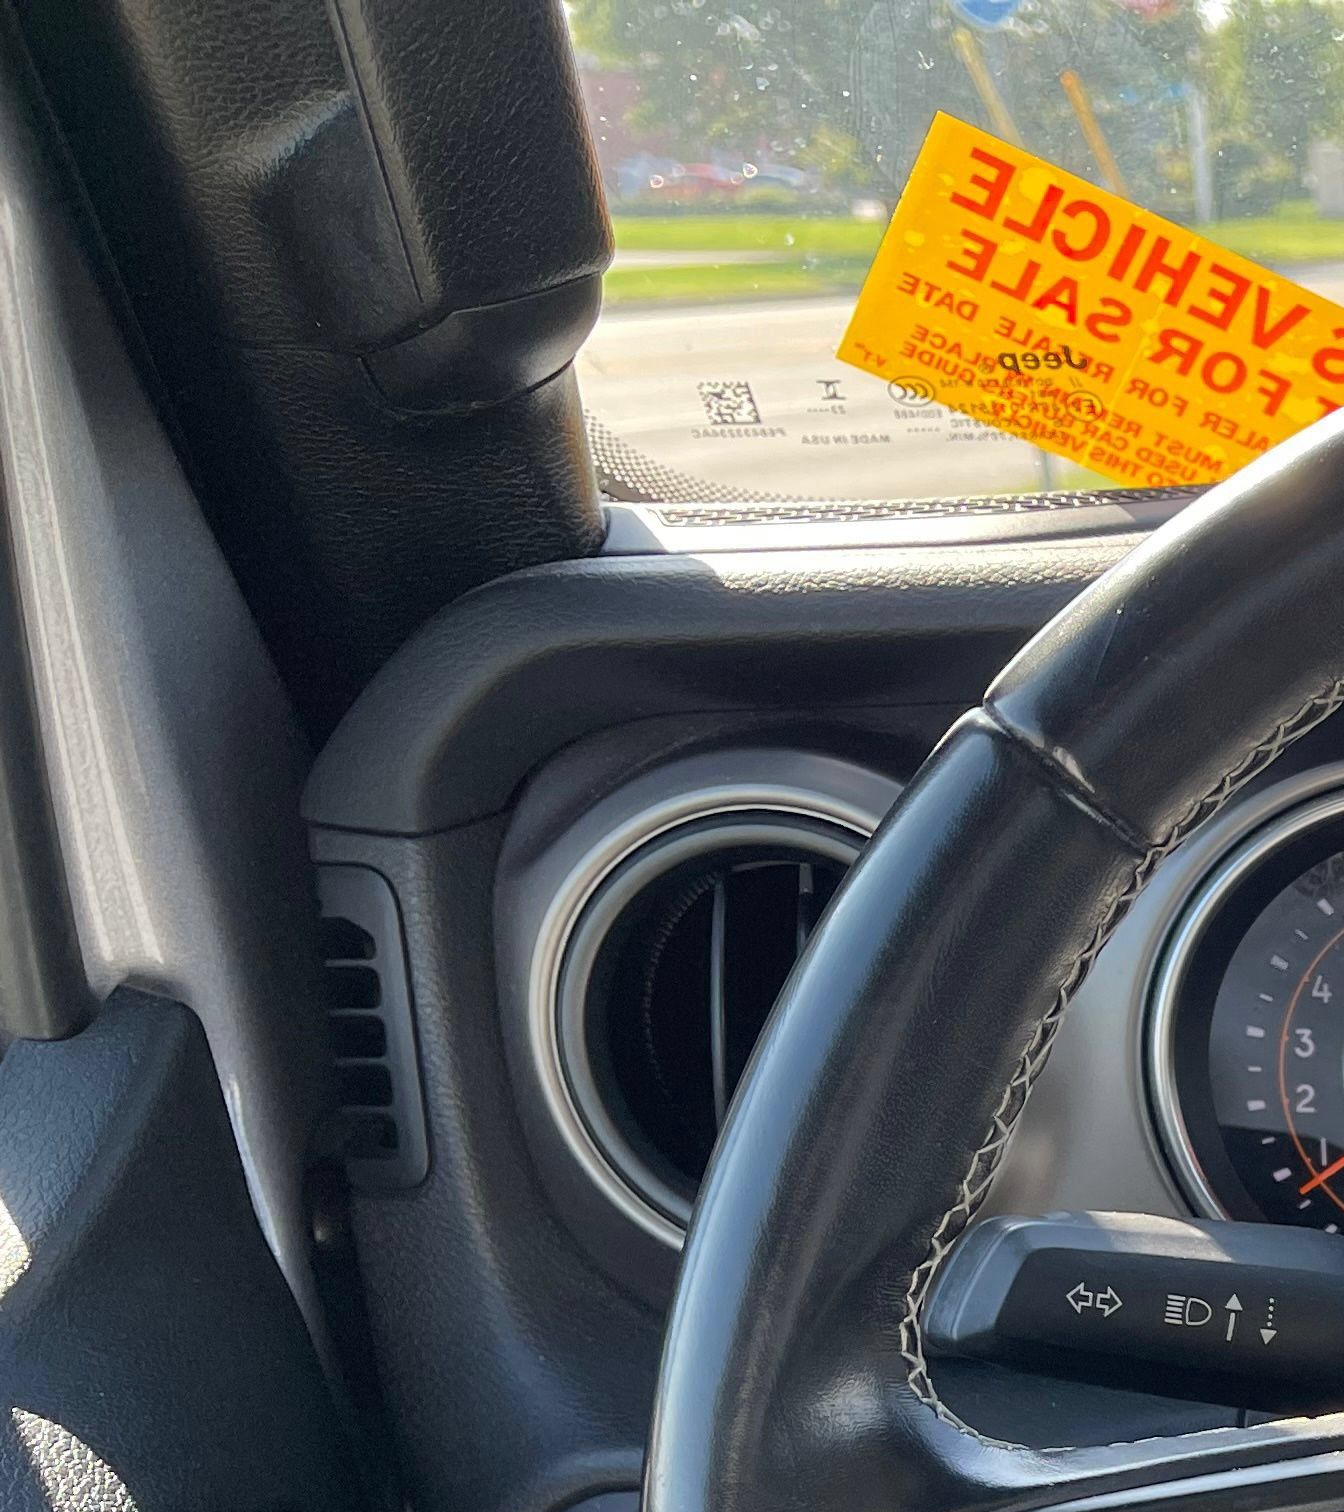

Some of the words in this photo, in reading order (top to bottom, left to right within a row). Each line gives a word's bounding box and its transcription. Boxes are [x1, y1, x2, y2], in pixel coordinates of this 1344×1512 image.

[1312, 976, 1333, 1003] 4
[1294, 1027, 1315, 1057] 3
[1295, 1085, 1316, 1114] 2
